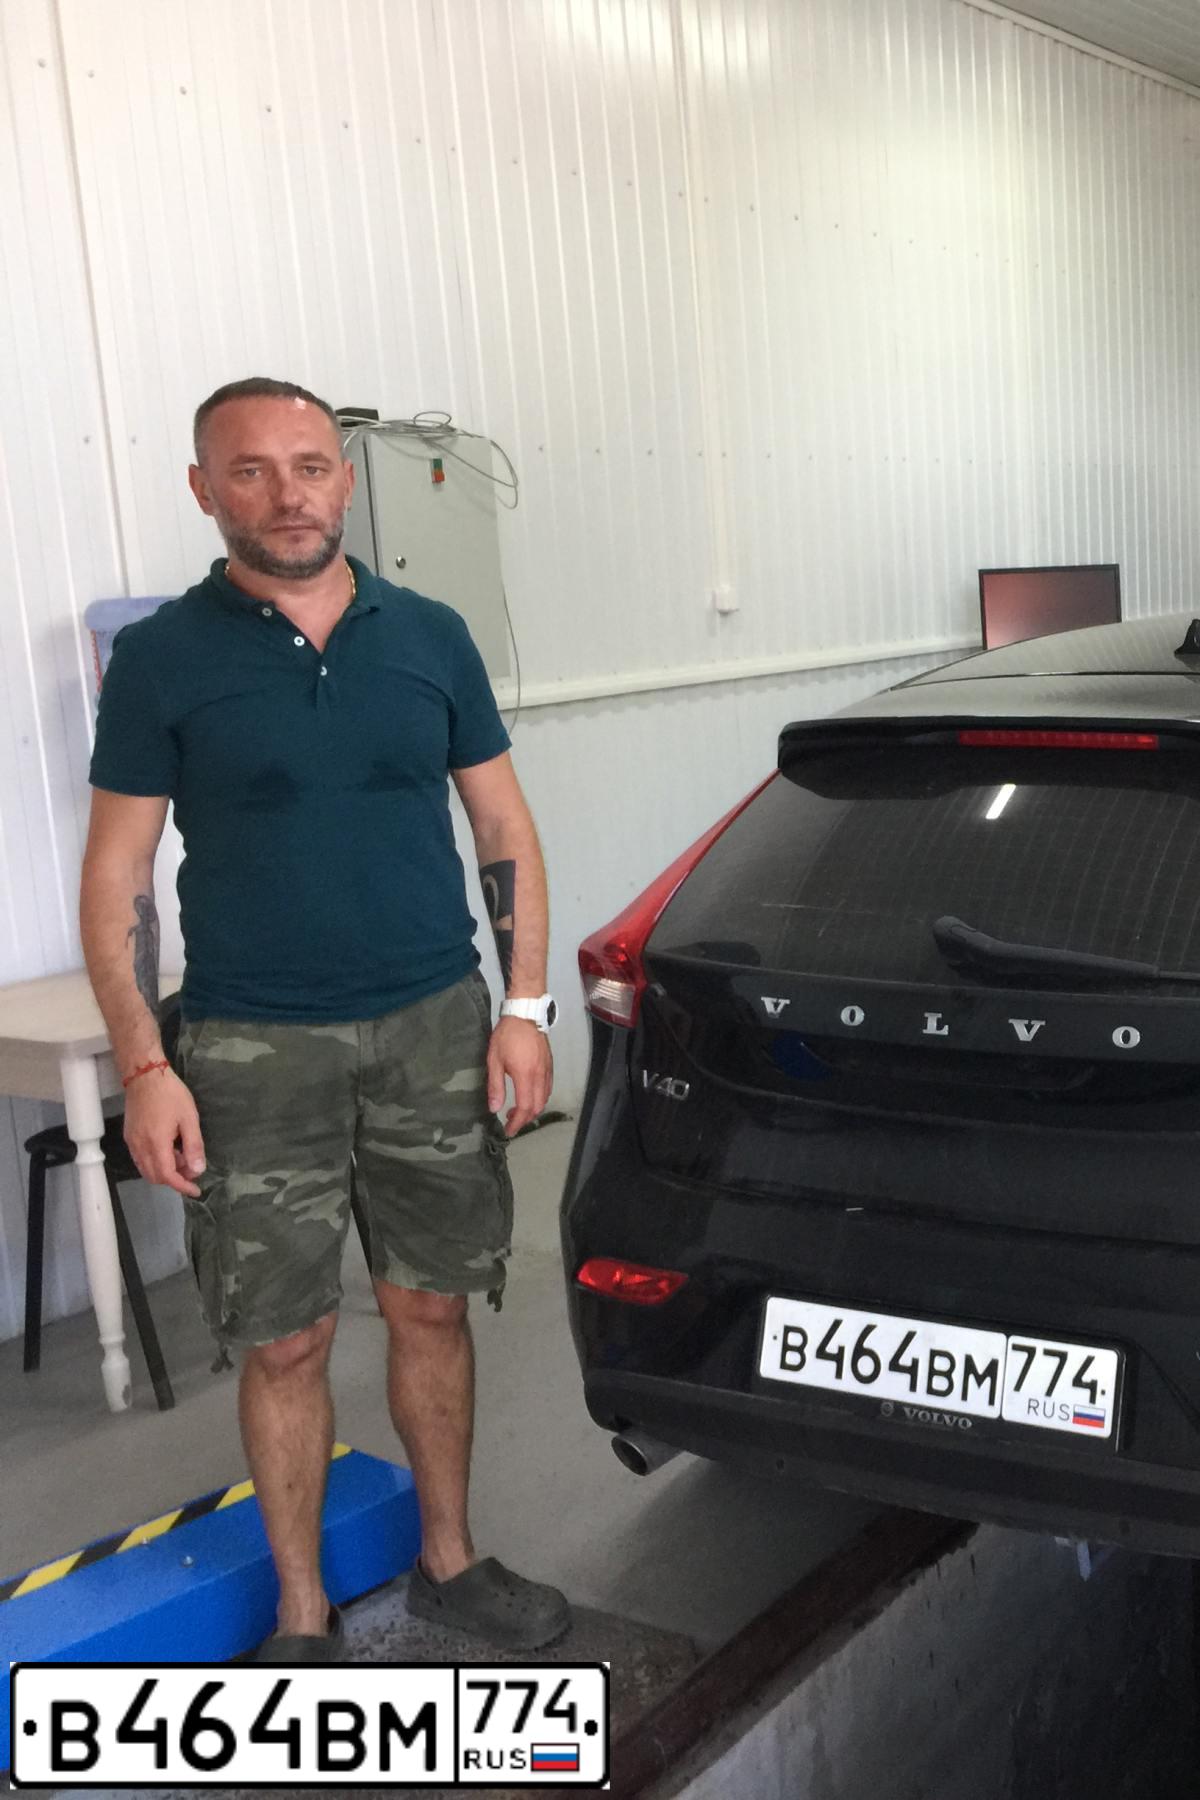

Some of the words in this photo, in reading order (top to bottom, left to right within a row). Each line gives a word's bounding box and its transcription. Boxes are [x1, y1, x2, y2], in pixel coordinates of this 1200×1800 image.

[761, 997, 1141, 1049] VOLVO
[642, 1069, 690, 1101] V40
[779, 1318, 999, 1407] B464BM
[1010, 1343, 1098, 1405] 774
[903, 1407, 973, 1429] VOLVO
[1026, 1397, 1071, 1422] RUS
